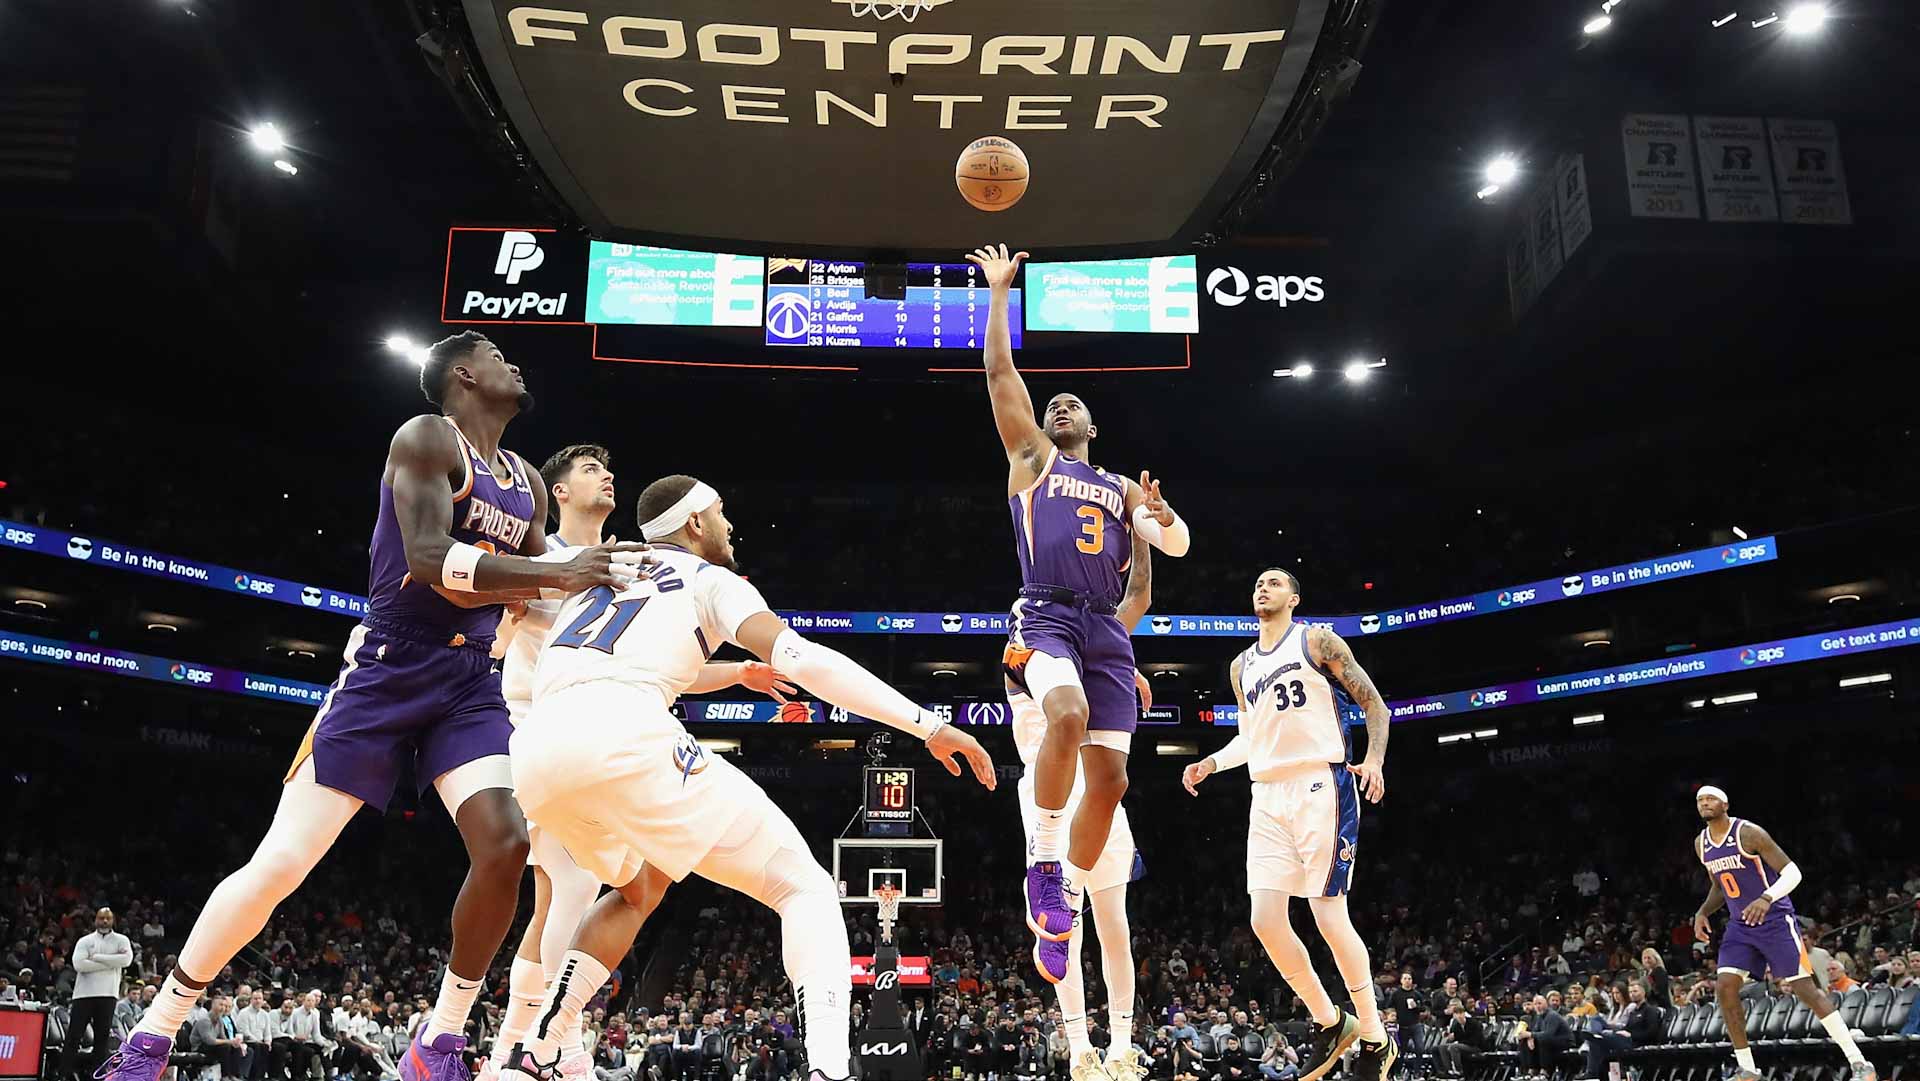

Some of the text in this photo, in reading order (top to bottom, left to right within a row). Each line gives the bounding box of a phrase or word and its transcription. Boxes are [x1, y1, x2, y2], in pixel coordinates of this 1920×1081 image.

[507, 7, 1285, 75] FOOTPRINT
[622, 78, 1168, 130] CENTER
[812, 264, 975, 275] 22 Ayton 5 0
[680, 282, 714, 291] Revol
[811, 276, 975, 288] 25 Bridges 2 2
[814, 288, 975, 300] 3 Beal 2 5
[1115, 288, 1150, 299] Revol
[1255, 275, 1325, 307] aps
[462, 291, 568, 319] PayPal
[814, 301, 820, 310] 9
[826, 301, 857, 311] Avdija
[897, 301, 904, 310] 2
[968, 303, 975, 312] 3
[811, 313, 822, 321] 21
[827, 312, 864, 322] Gafford
[895, 313, 907, 322] 10
[969, 314, 974, 324] 1
[810, 325, 974, 336] 22 Morris 7 0 1
[810, 337, 975, 348] 33 Kuzma 14 5 4
[5, 528, 36, 544] aps
[1076, 505, 1104, 555] 3
[1739, 544, 1766, 560] aps
[101, 547, 209, 580] Be in the know.
[1591, 559, 1695, 587] Be in the know.
[250, 579, 275, 594] aps
[330, 595, 346, 608] Be
[349, 599, 360, 612] in
[1512, 588, 1536, 603] aps
[549, 584, 651, 655] 21
[792, 616, 813, 627] the
[816, 616, 852, 627] know.
[1387, 601, 1475, 626] Be in the know.
[892, 618, 915, 630] aps
[970, 618, 986, 629] Be
[990, 618, 1002, 629] in
[1180, 620, 1259, 631] Be in the kno
[1821, 638, 1846, 651] Get
[1849, 634, 1876, 647] text
[1879, 627, 1906, 641] and
[0, 640, 139, 671] ges, usage and more.
[1757, 647, 1785, 662] aps
[187, 668, 213, 683] aps
[1537, 660, 1705, 695] Learn more at aps.com/alerts
[245, 678, 276, 693] Learn
[279, 683, 309, 698] more
[311, 687, 322, 701] at
[1274, 680, 1307, 711] 33
[1485, 690, 1508, 704] aps
[705, 704, 755, 720] SUNS
[830, 705, 848, 723] 48
[933, 705, 952, 723] 55
[1394, 700, 1445, 716] and more.
[1198, 711, 1213, 722] 10
[877, 772, 908, 786] 11:29
[884, 786, 904, 807] 10
[1720, 872, 1741, 898] 0
